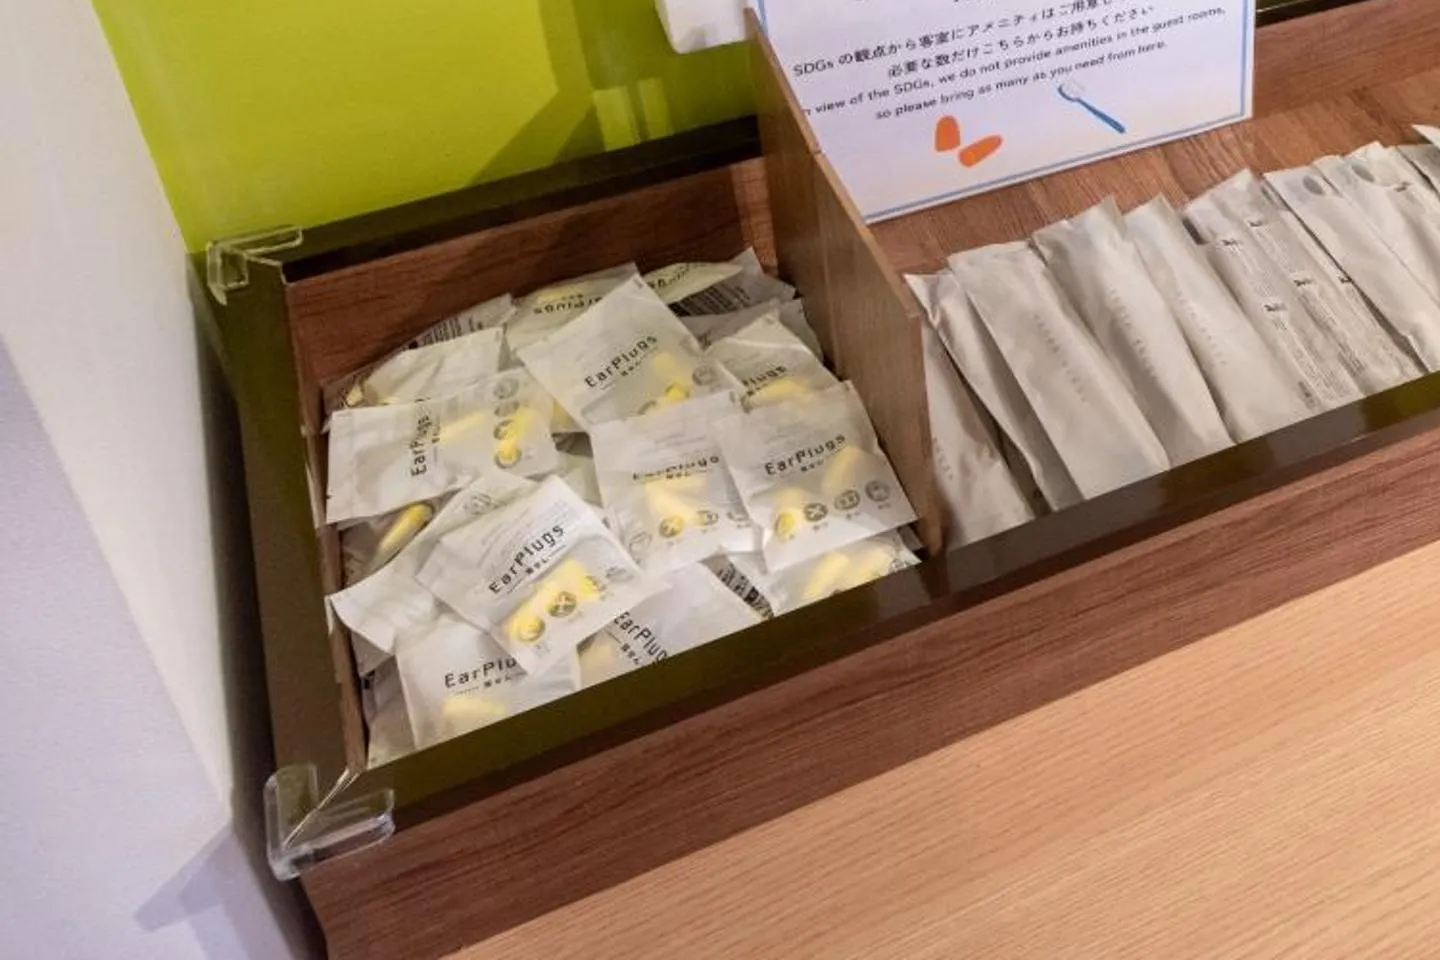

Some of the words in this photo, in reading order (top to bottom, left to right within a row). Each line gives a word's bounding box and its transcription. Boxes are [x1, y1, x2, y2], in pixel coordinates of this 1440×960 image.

[815, 97, 846, 113] view
[849, 91, 865, 106] of
[867, 87, 890, 101] the
[959, 66, 977, 79] do
[979, 60, 1001, 75] not
[1003, 46, 1051, 70] provide
[1055, 33, 1113, 56] amenities
[1130, 23, 1150, 37] the
[875, 109, 892, 120] so
[894, 97, 937, 117] please
[940, 86, 975, 105] bring
[978, 83, 992, 95] as
[995, 74, 1030, 91] many
[1032, 69, 1048, 81] as
[1050, 63, 1073, 78] you
[1074, 56, 1104, 71] need
[583, 335, 658, 388] EarPlugs
[763, 434, 847, 477] EarPlugs
[488, 524, 566, 594] EarPlugs
[444, 657, 518, 689] EarPlu
